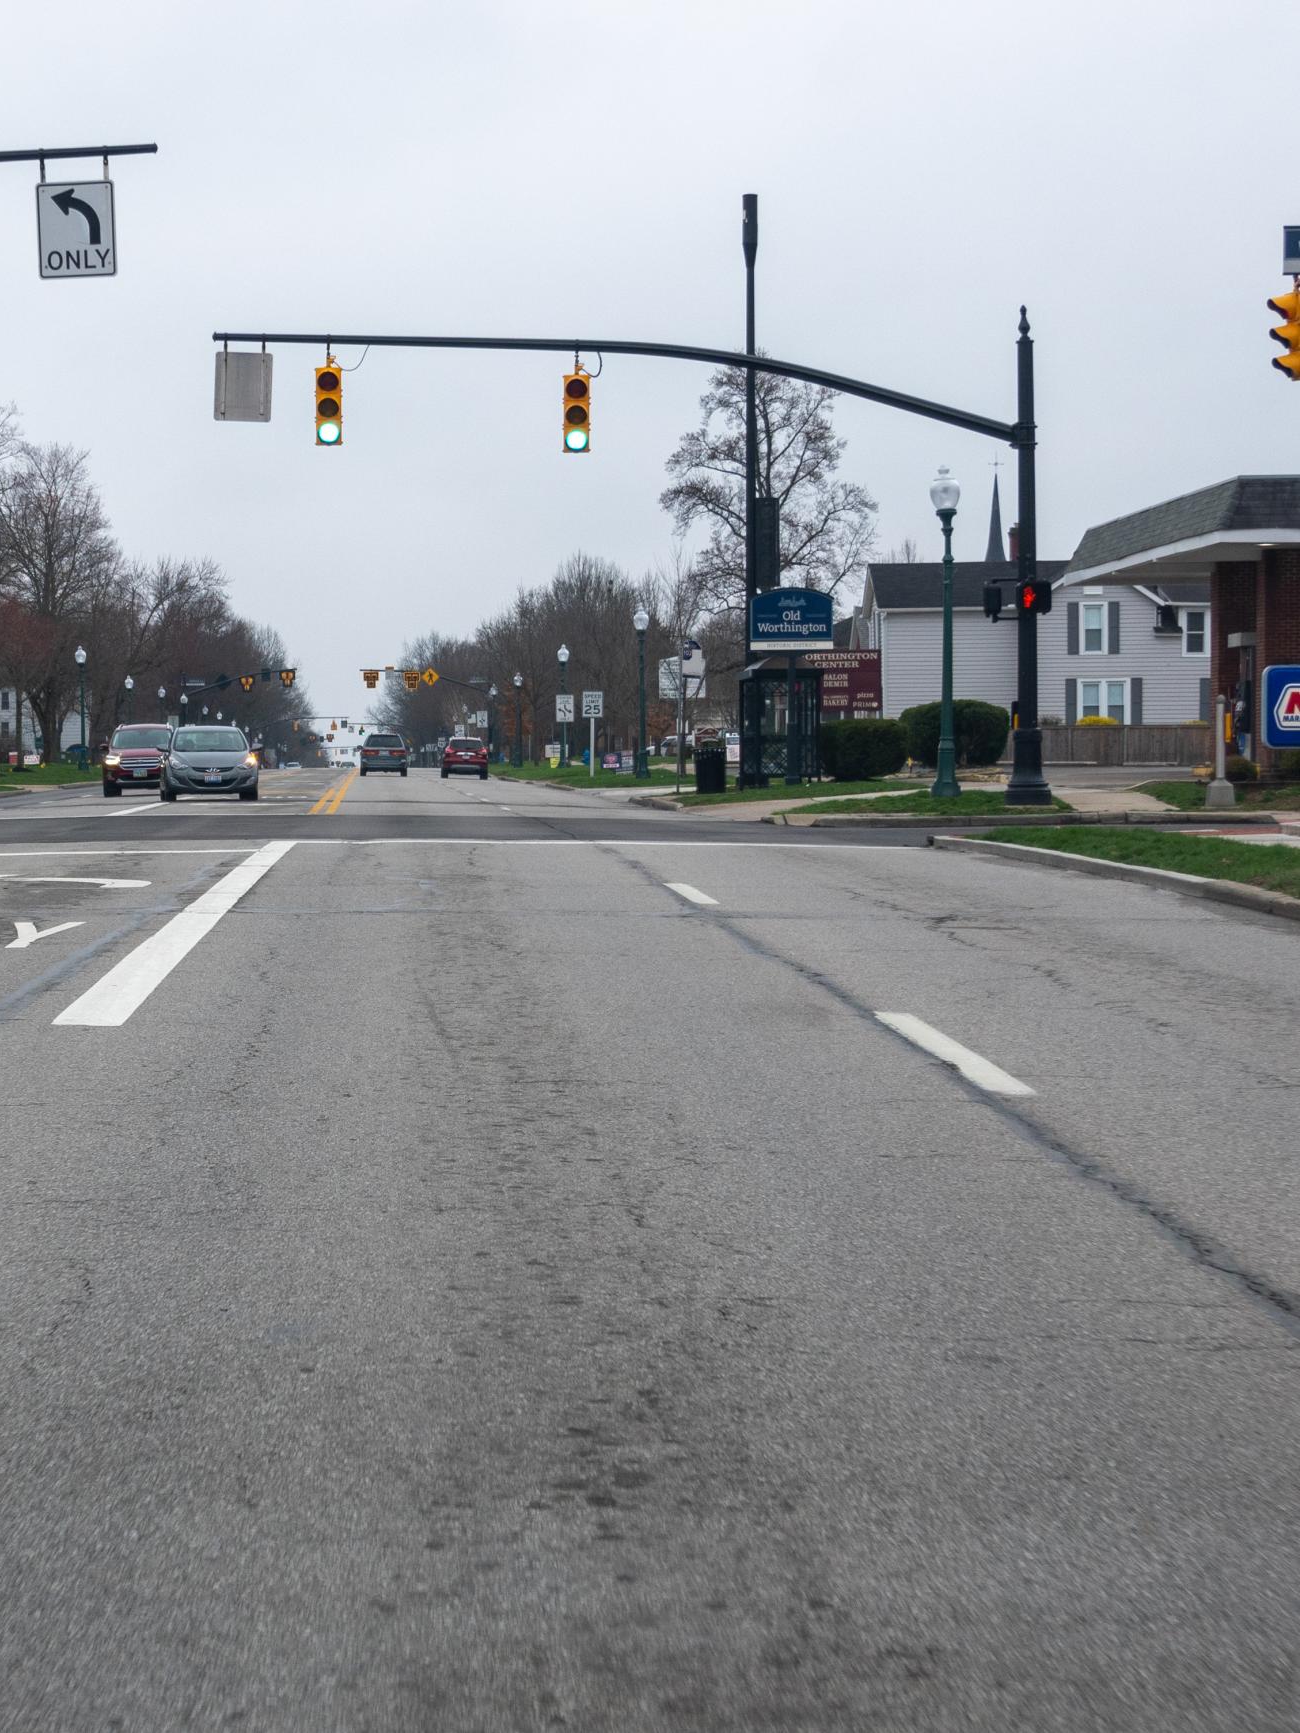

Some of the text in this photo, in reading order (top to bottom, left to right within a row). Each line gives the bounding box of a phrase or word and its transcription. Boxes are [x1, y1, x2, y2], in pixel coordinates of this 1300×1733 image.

[47, 248, 110, 271] ONLY
[782, 610, 801, 621] Old
[757, 622, 827, 635] Worthington
[802, 652, 878, 661] ORTHINGTON
[814, 660, 860, 668] CENTER
[584, 704, 601, 715] 25
